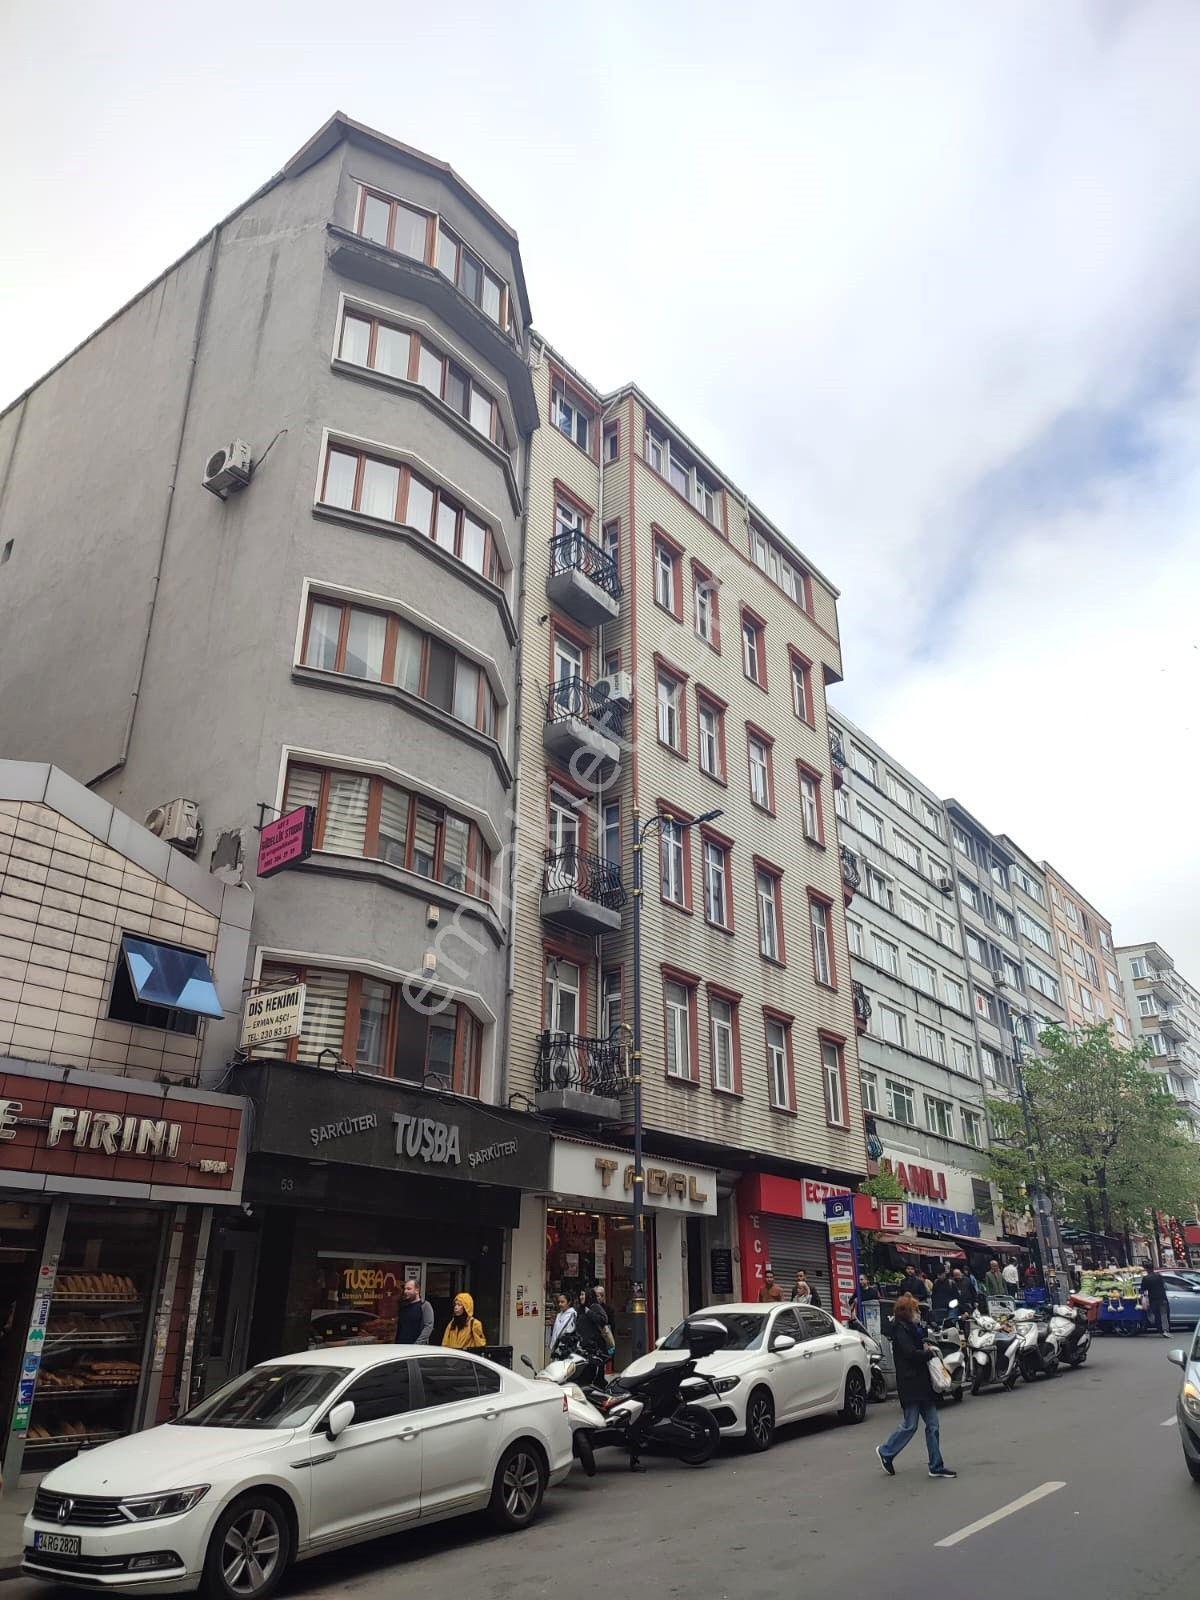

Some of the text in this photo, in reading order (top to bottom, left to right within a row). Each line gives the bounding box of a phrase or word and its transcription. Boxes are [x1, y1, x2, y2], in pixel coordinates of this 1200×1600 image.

[265, 992, 299, 1012] HEKİMİ
[252, 1018, 274, 1030] ERMAN
[260, 1029, 273, 1040] 230
[47, 1106, 182, 1158] FIRINI
[310, 1112, 378, 1146] ŞARKÜTERİ
[392, 1112, 461, 1165] TUŞBA
[468, 1136, 519, 1168] ŞARKÜTERİ
[47, 1536, 60, 1550] RG
[60, 1538, 78, 1553] 2820
